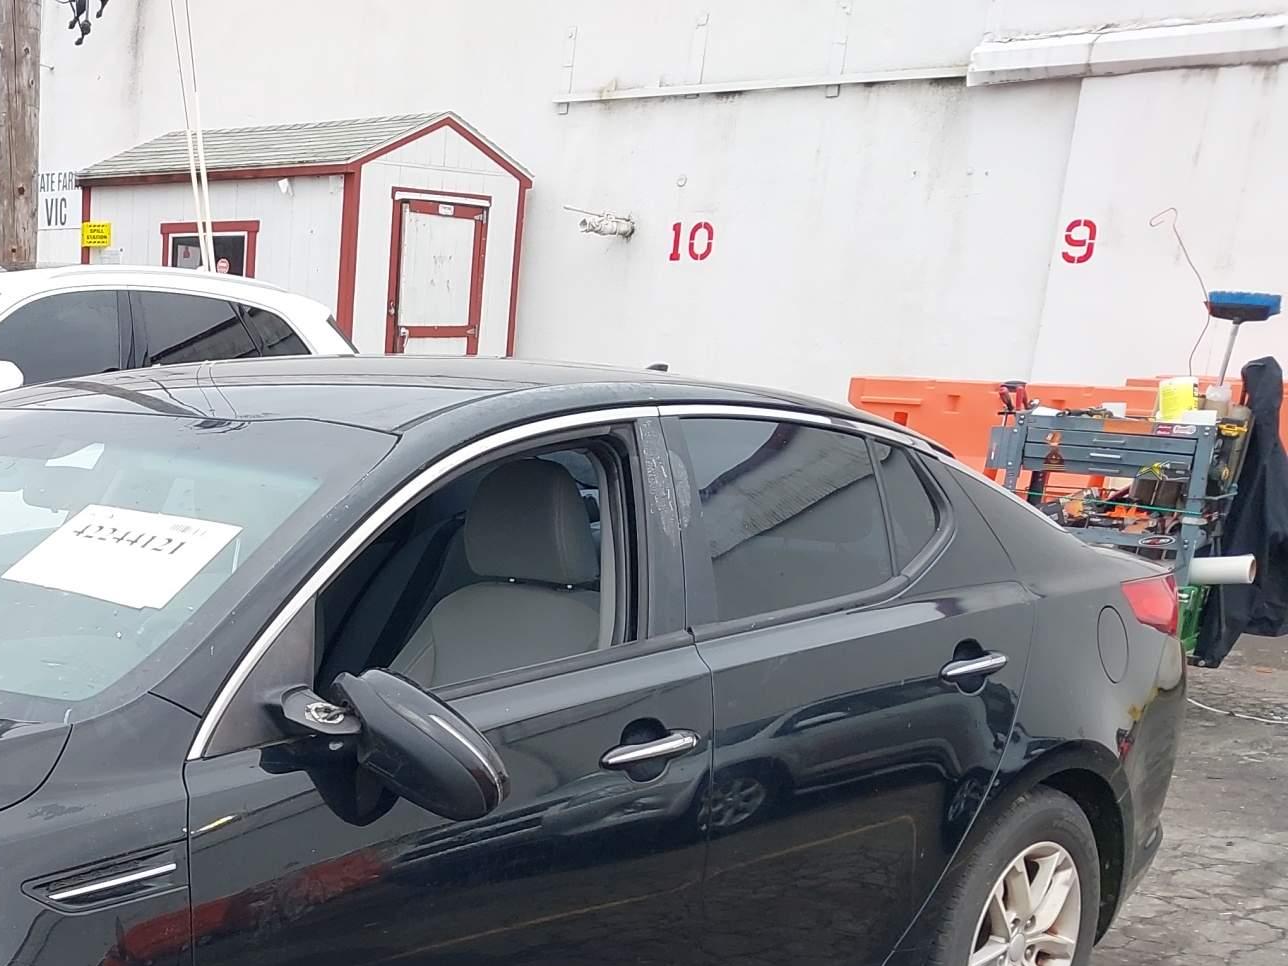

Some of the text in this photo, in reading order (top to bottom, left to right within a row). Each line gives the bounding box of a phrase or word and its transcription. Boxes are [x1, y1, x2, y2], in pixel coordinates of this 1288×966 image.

[45, 197, 67, 226] VIC
[669, 221, 714, 261] 10
[1062, 219, 1097, 264] 9
[73, 523, 186, 555] 42244121
